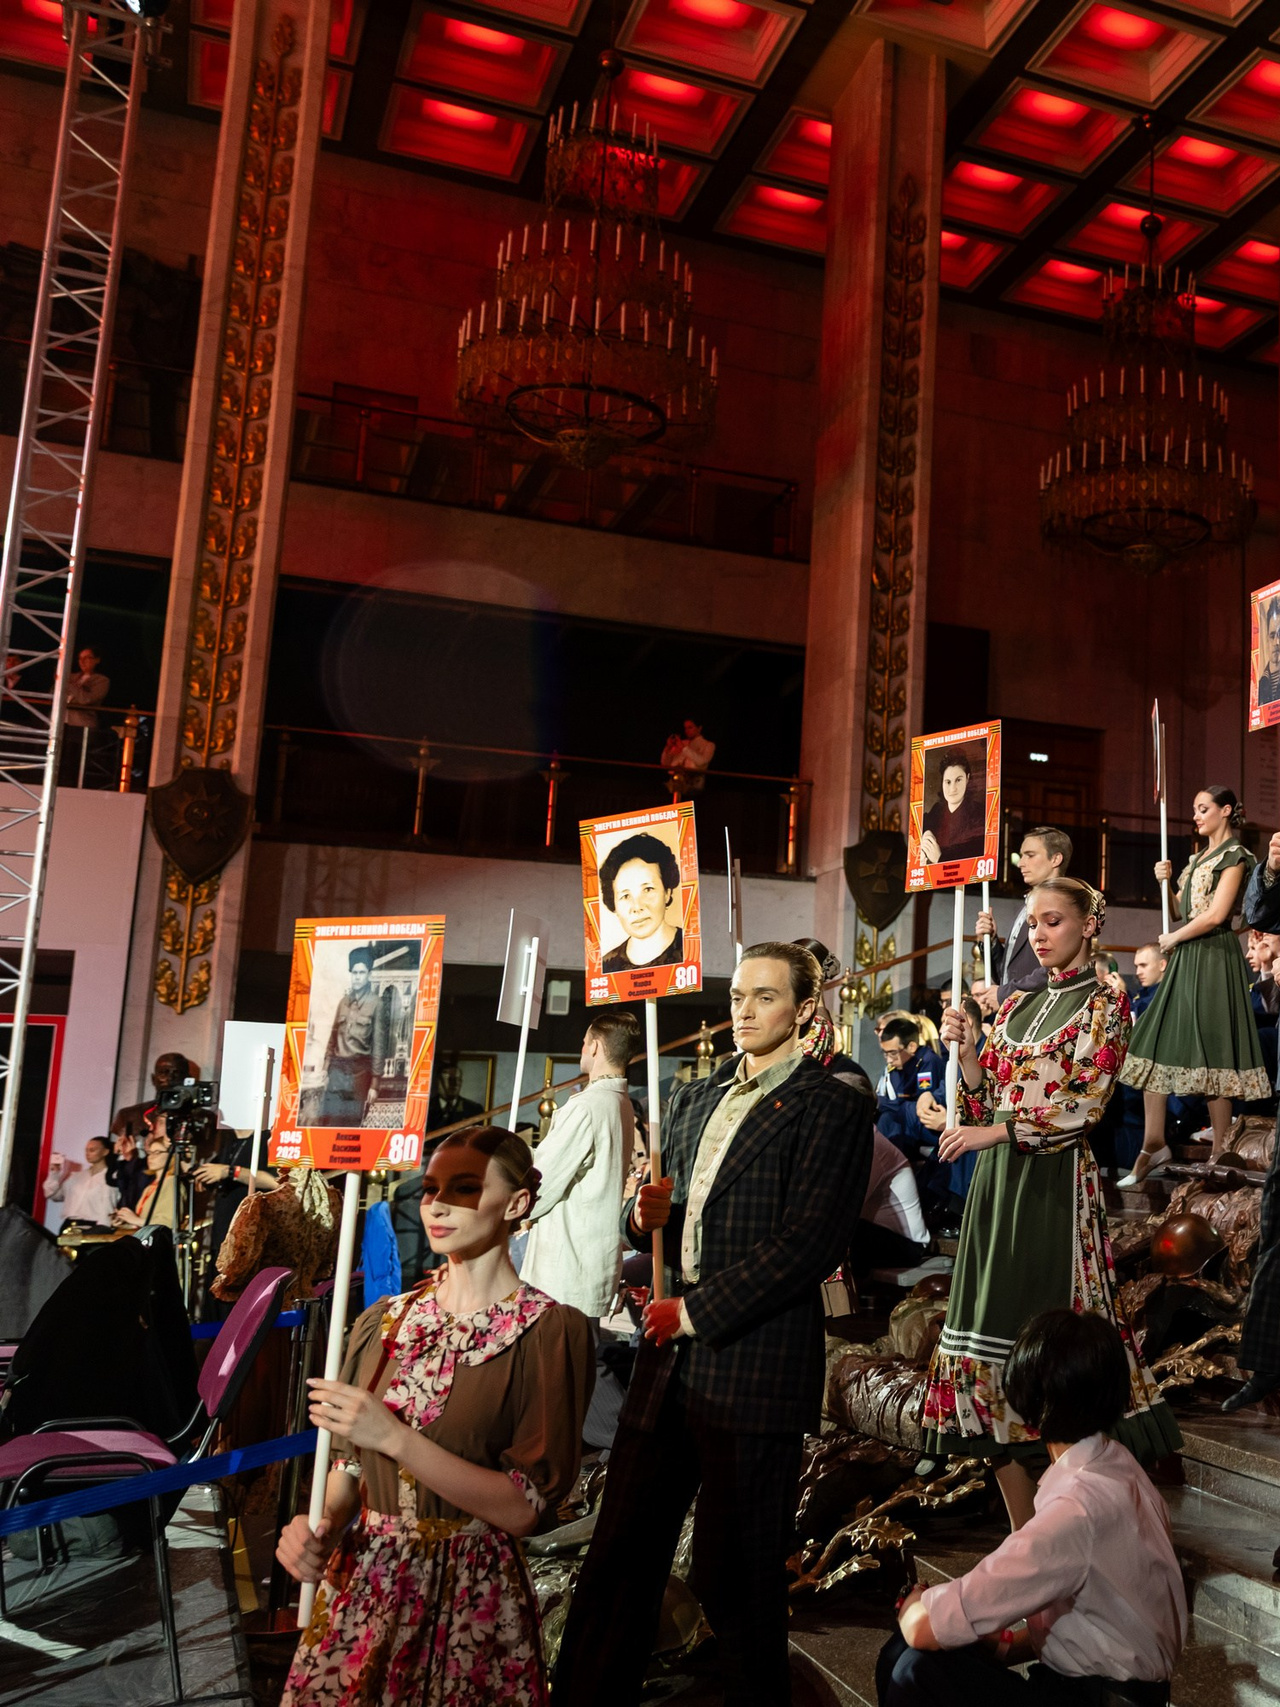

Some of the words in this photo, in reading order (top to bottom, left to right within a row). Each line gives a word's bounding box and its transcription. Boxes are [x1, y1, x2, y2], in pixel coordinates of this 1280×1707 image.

[594, 821, 621, 832] ЭНЕРГИЯ
[622, 814, 650, 830] ВЕЛИКОЙ
[651, 810, 679, 822] ПОБЕДЫ
[911, 868, 925, 878] 1945
[977, 859, 995, 879] 80
[910, 878, 925, 887] 2025
[315, 924, 351, 937] ЭНЕРГИЯ
[351, 922, 388, 936] ВЕЛИКОЙ
[389, 922, 426, 936] ПОБЕДЫ
[591, 977, 608, 988] 1945
[676, 966, 697, 989] 80
[590, 989, 609, 999] 2025
[279, 1130, 303, 1144] 1945
[275, 1146, 301, 1159] 2025
[388, 1133, 419, 1165] 80
